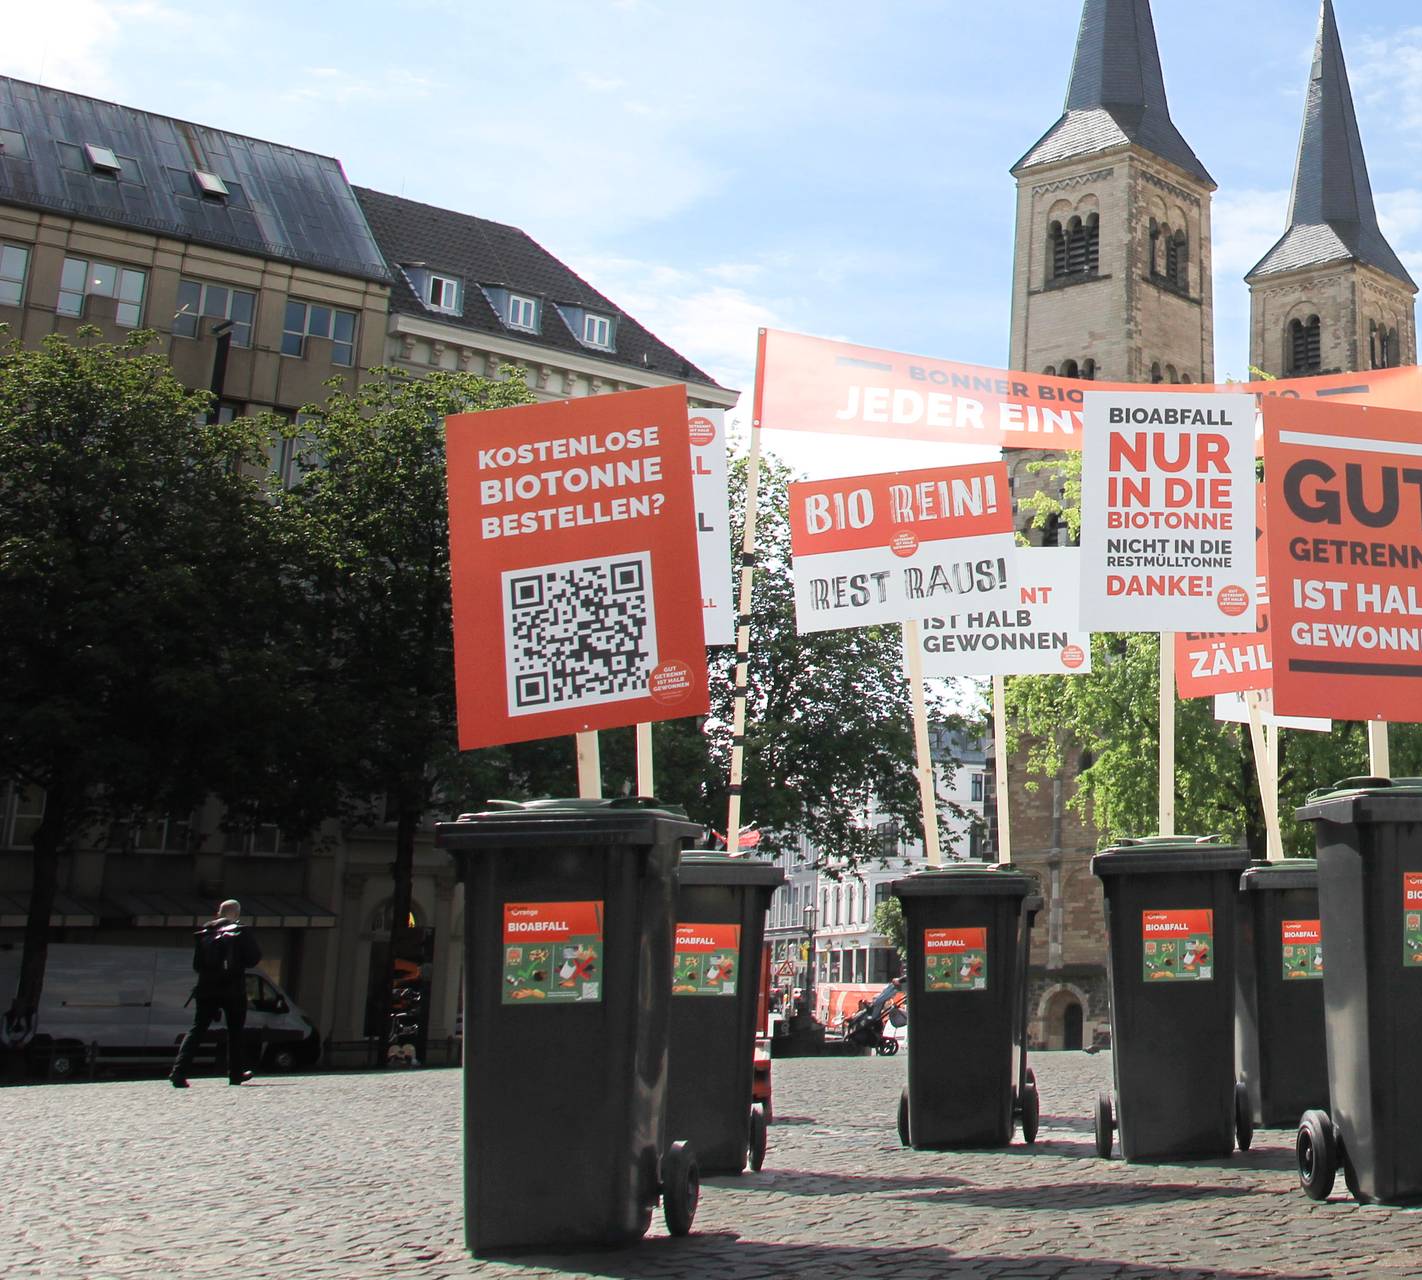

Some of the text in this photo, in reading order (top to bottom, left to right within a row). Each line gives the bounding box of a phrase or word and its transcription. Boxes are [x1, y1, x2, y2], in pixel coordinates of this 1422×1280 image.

[909, 365, 1029, 398] BONNER
[836, 385, 984, 429] JEDER
[1109, 407, 1233, 426] BIOABFALL
[478, 426, 660, 470] KOSTENLOSE
[1108, 431, 1232, 474] NUR
[480, 456, 663, 505] BIOTONNE
[1107, 476, 1233, 508] IN DIE
[805, 475, 997, 535] BIO REIN!
[481, 493, 665, 540] BESTELLEN?
[1107, 511, 1233, 530] BIOTONNE
[1107, 539, 1232, 555] NICHT IN DIE
[1106, 554, 1232, 568] RESTMÜLLTONNE
[810, 558, 1007, 611] REST RAUS!
[1106, 575, 1213, 597] DANKE!
[1293, 578, 1348, 611] IST
[967, 610, 1032, 629] HALB
[922, 632, 1068, 653] GEWONNEN
[507, 921, 569, 932] BIOABFALL
[1145, 923, 1189, 931] BIOABFALL
[1284, 931, 1318, 939] BIOABFALL
[676, 937, 716, 945] IOABFALL
[927, 939, 966, 948] BIOABFALL
